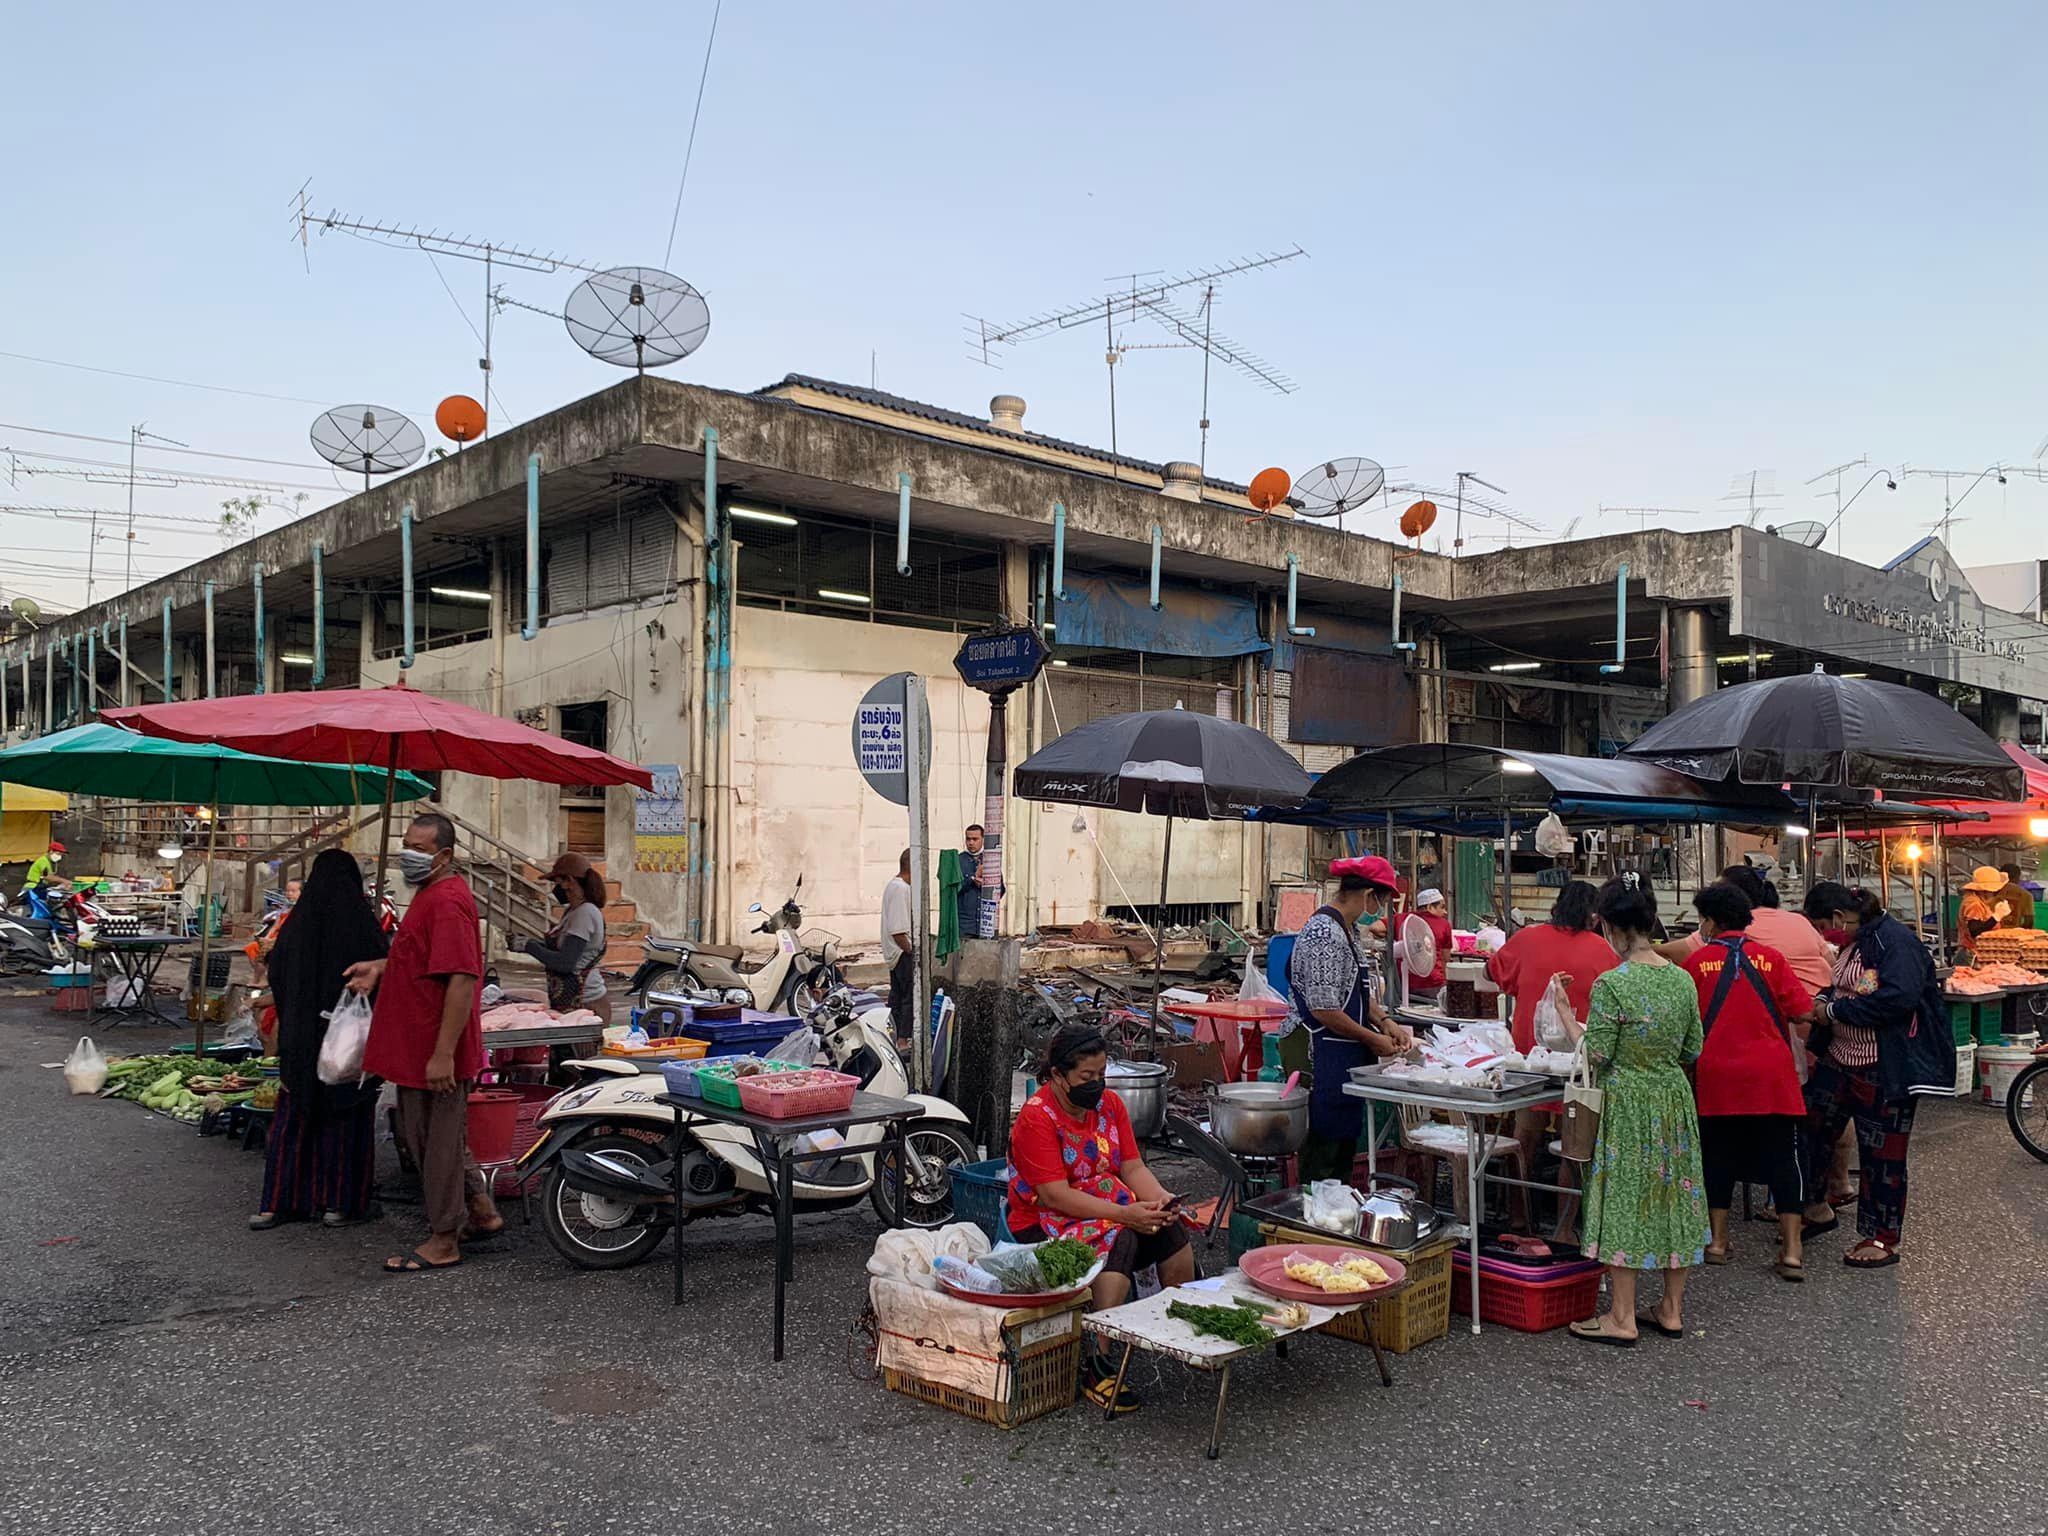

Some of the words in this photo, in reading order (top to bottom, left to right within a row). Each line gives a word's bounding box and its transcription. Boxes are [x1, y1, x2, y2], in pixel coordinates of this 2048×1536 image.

[1024, 638, 1030, 655] 2
[976, 669, 986, 677] Soi
[861, 707, 901, 725] รถรับจ้าง
